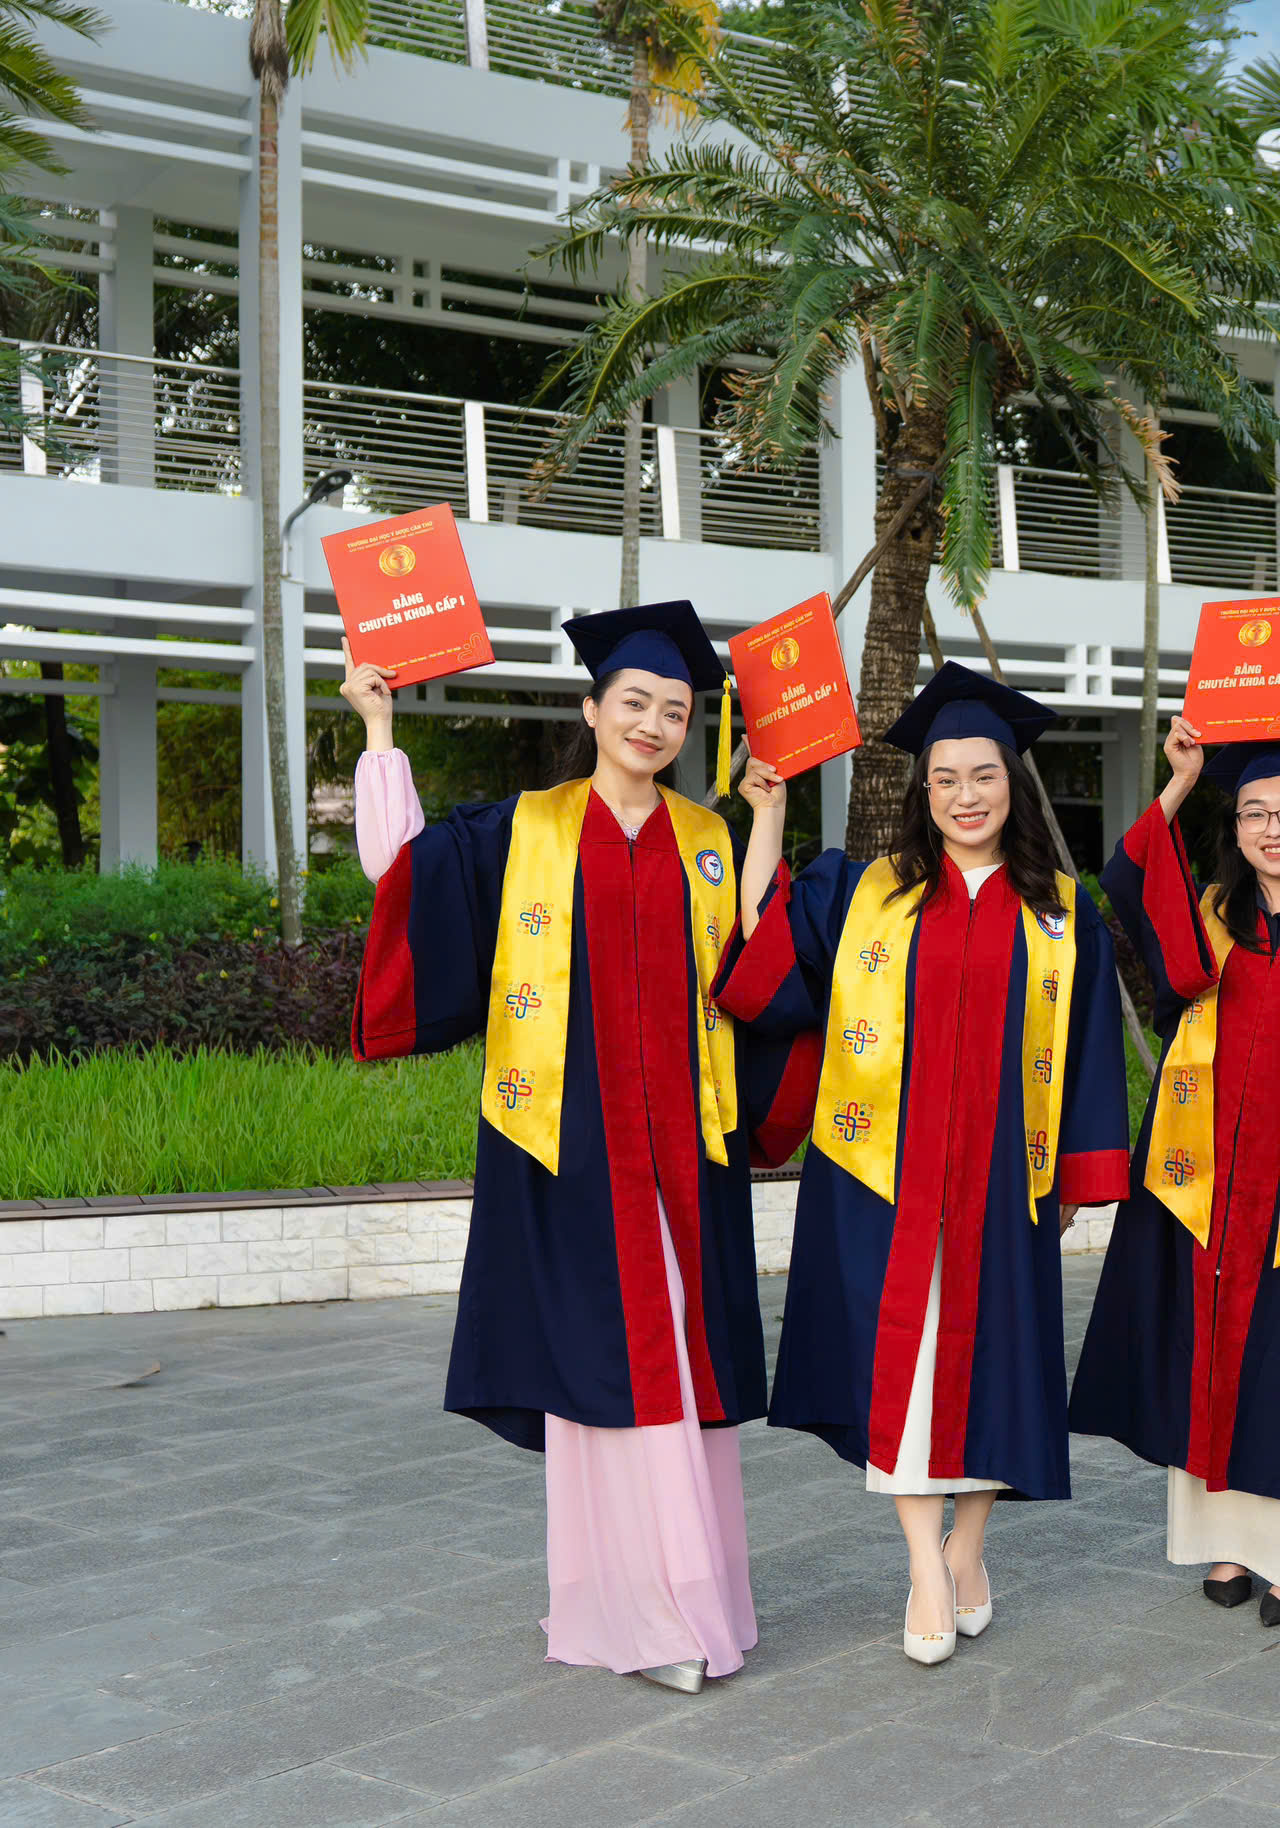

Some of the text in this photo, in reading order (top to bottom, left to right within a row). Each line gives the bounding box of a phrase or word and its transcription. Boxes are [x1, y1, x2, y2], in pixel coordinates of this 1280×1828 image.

[392, 592, 424, 610] BẰNG
[358, 595, 465, 633] CHUYÊN KHOA CẤP I
[1234, 662, 1262, 675] BẰNG
[1198, 676, 1237, 689] CHUYÊN
[1239, 676, 1265, 687] KHOA
[782, 683, 806, 702] BẰNG
[756, 681, 838, 728] CHUYÊN KHOA CẤP I
